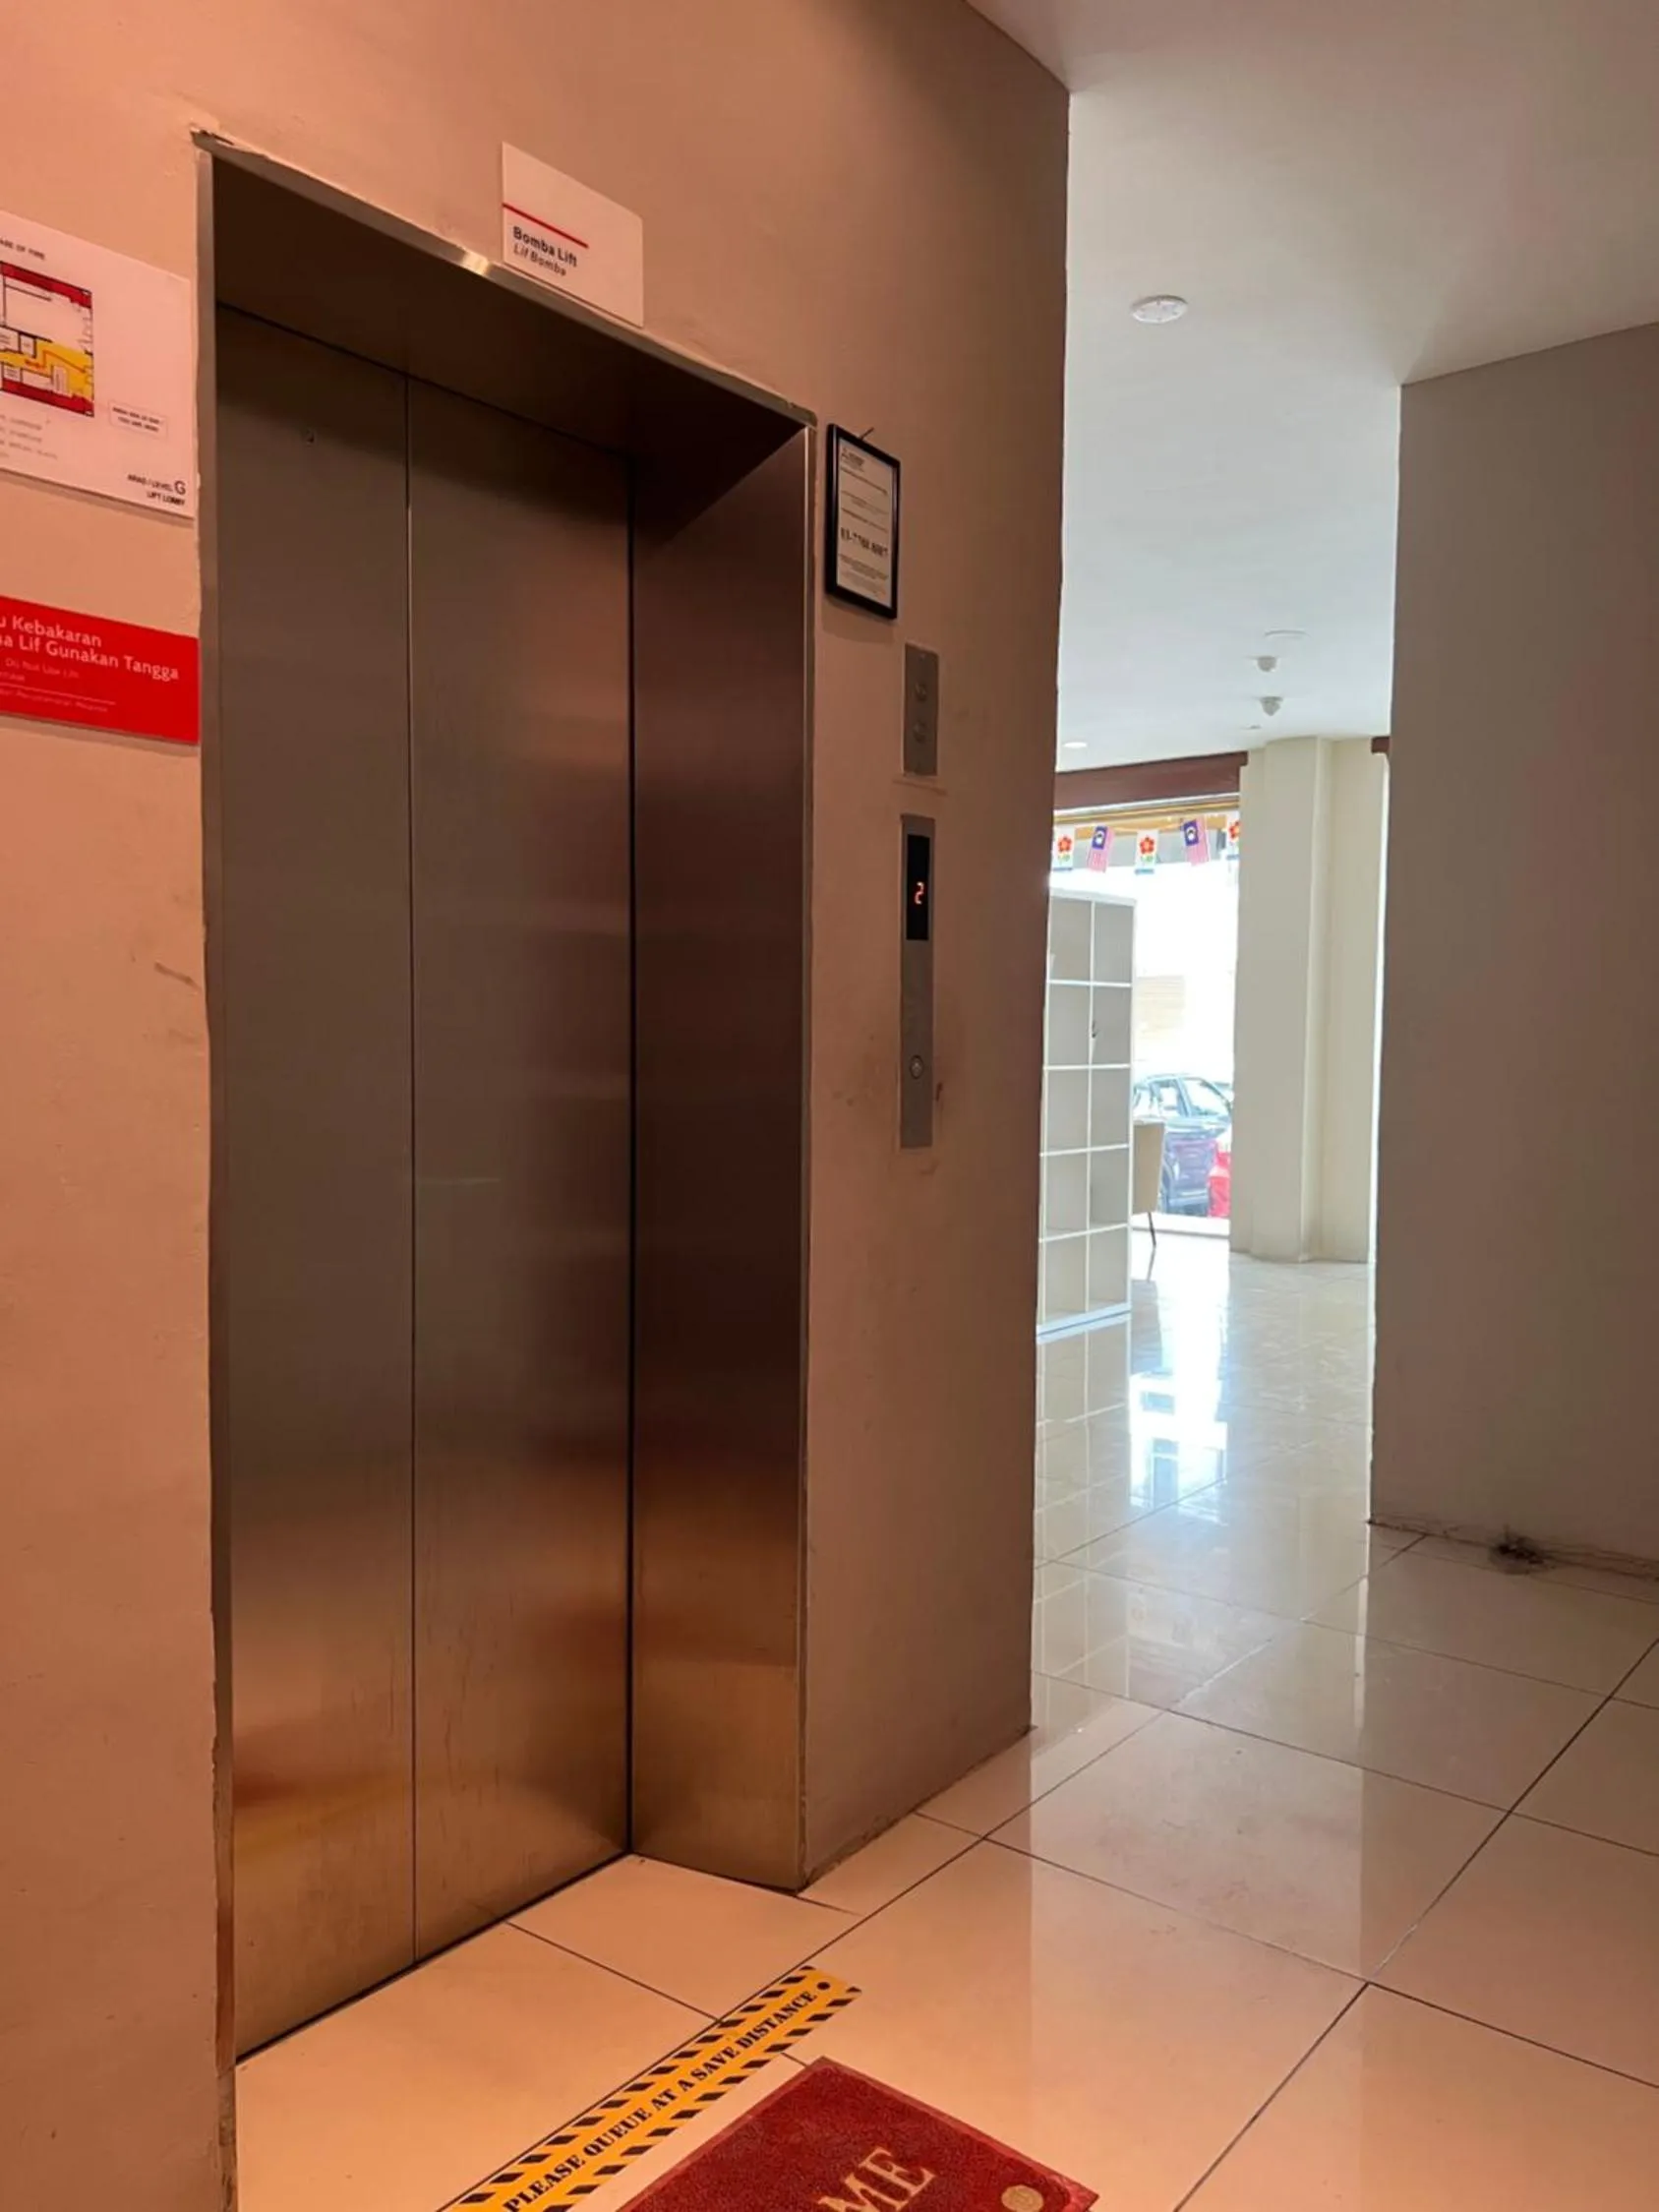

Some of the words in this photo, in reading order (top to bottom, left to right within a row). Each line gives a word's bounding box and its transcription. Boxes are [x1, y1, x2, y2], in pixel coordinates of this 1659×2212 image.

[513, 225, 555, 256] Bomba
[558, 248, 576, 268] Lift
[513, 242, 528, 258] Lif
[530, 251, 566, 276] Bomba
[174, 480, 186, 495] G
[13, 616, 101, 647] Kebakaran
[20, 635, 40, 653] Lif
[46, 640, 119, 668] Gunakan
[124, 654, 179, 682] Tangga
[914, 881, 925, 905] 2
[503, 2154, 586, 2212] PLEASE
[582, 2107, 652, 2157] QUEUE
[650, 2088, 677, 2111] AT
[678, 2079, 694, 2092] A
[690, 2046, 740, 2081] SAVE
[735, 1991, 817, 2049] DISTANCE
